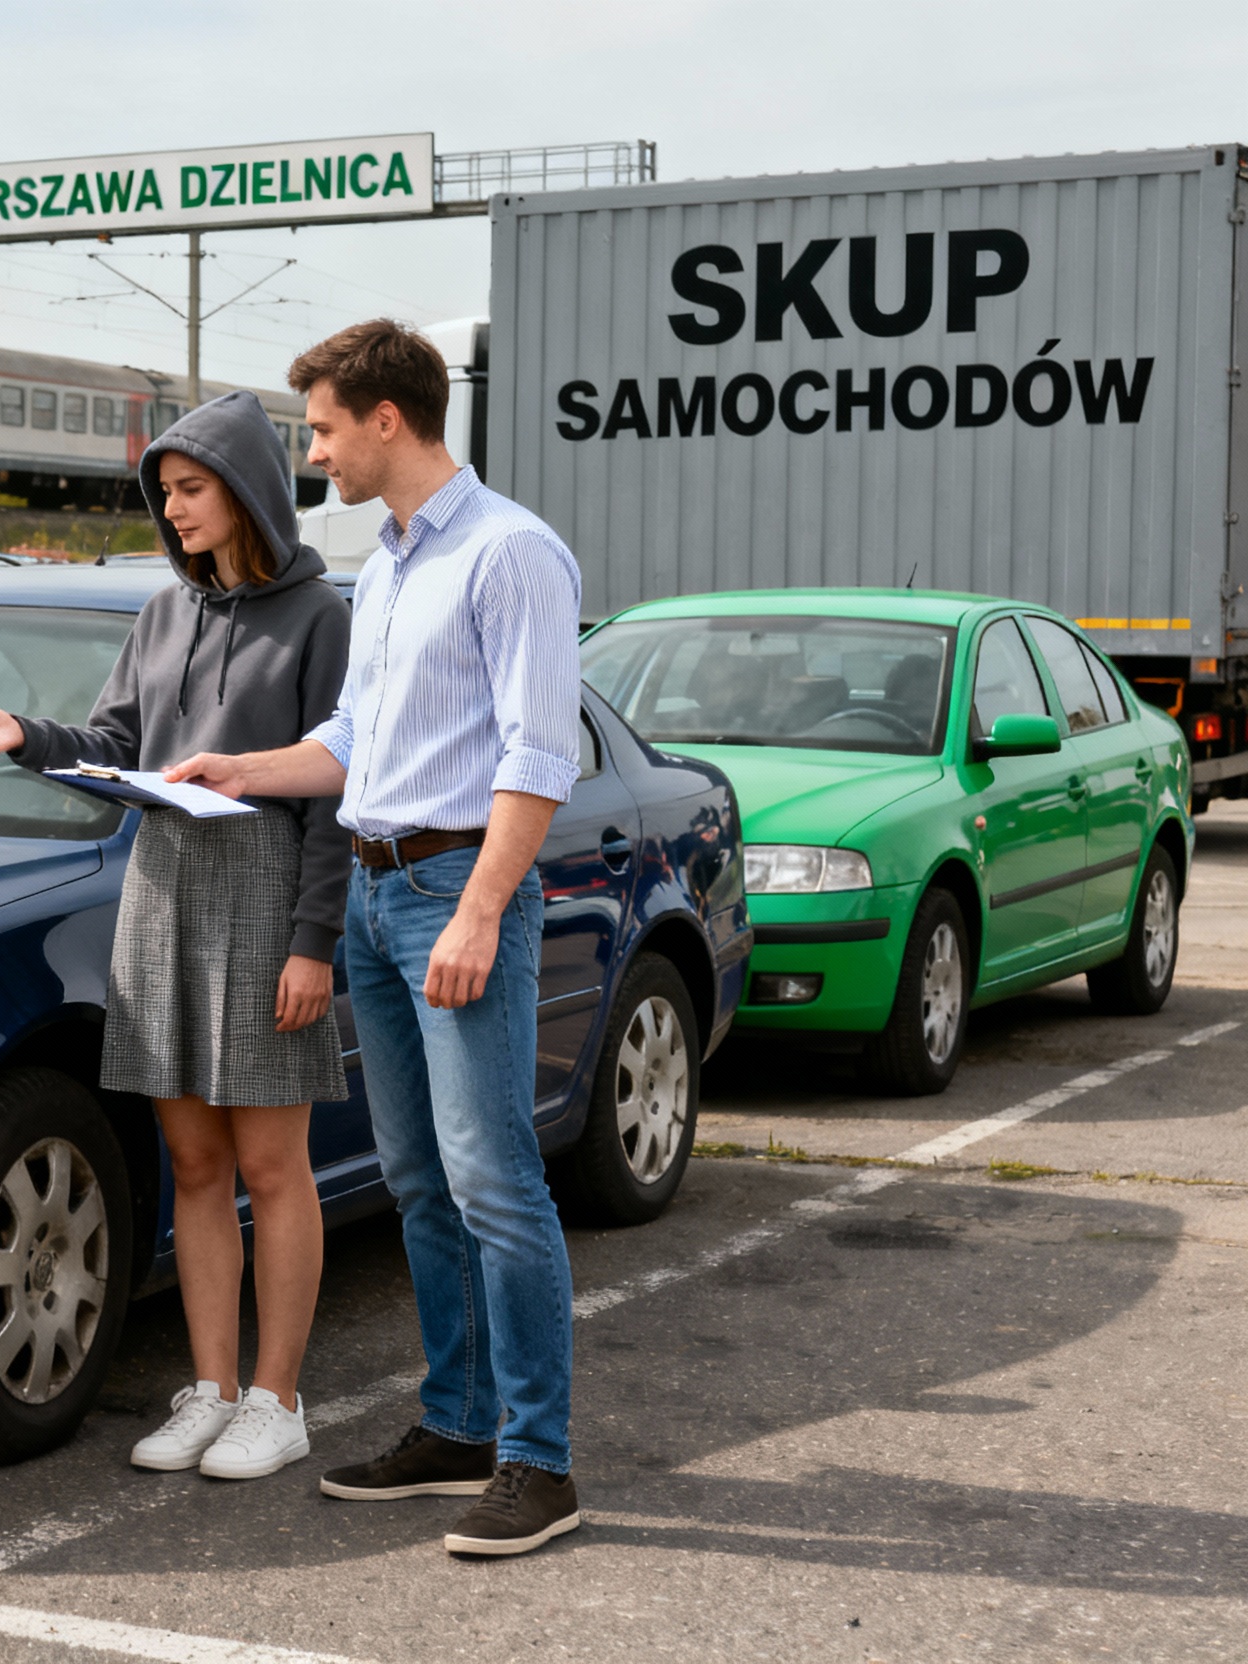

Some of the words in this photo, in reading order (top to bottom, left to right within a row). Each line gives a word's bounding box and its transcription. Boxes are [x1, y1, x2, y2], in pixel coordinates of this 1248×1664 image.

[179, 151, 414, 209] DZIELNICA
[667, 228, 1031, 346] SKUP
[555, 338, 1155, 442] SAMOCHODÓW
